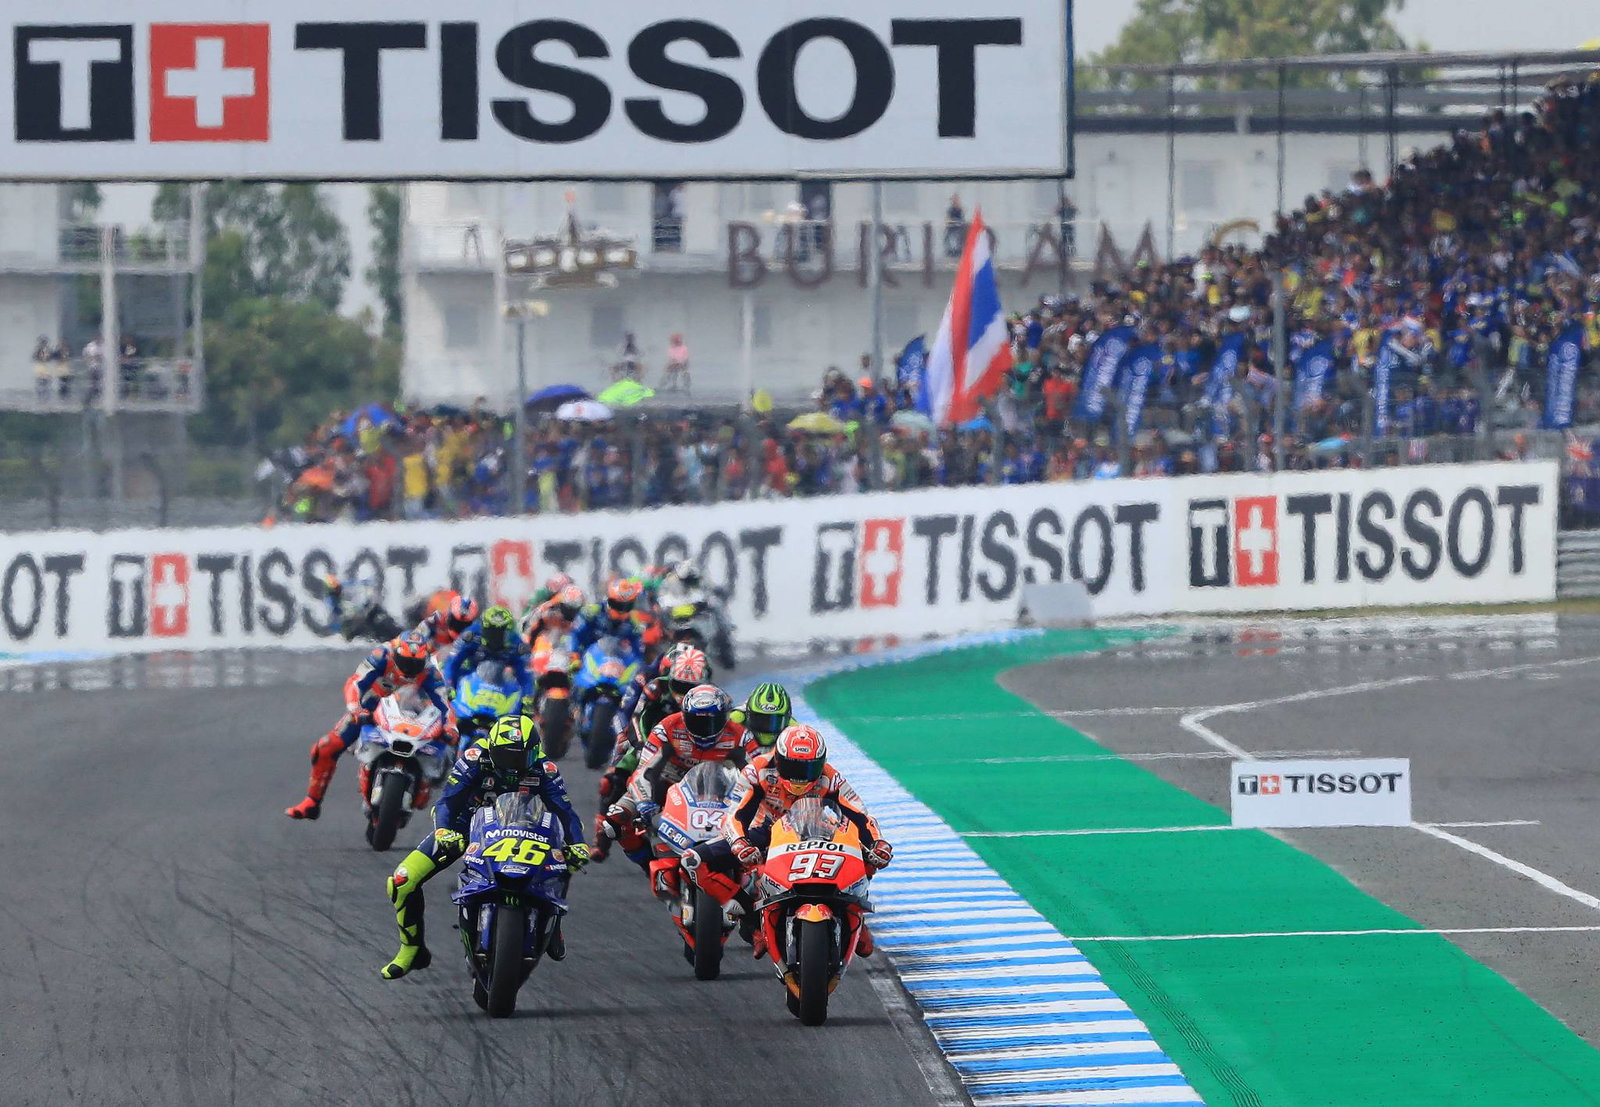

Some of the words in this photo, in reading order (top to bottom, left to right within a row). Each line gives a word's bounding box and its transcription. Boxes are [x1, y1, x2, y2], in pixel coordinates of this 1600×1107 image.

[294, 17, 1022, 144] TISSOT
[1287, 486, 1540, 583] TISSOT
[913, 503, 1160, 604] TISSOT
[1284, 773, 1403, 794] TISSOT
[691, 809, 724, 829] 04
[501, 829, 549, 843] movistar
[786, 841, 846, 852] REPSOL
[482, 837, 551, 866] 46
[787, 852, 846, 882] 93
